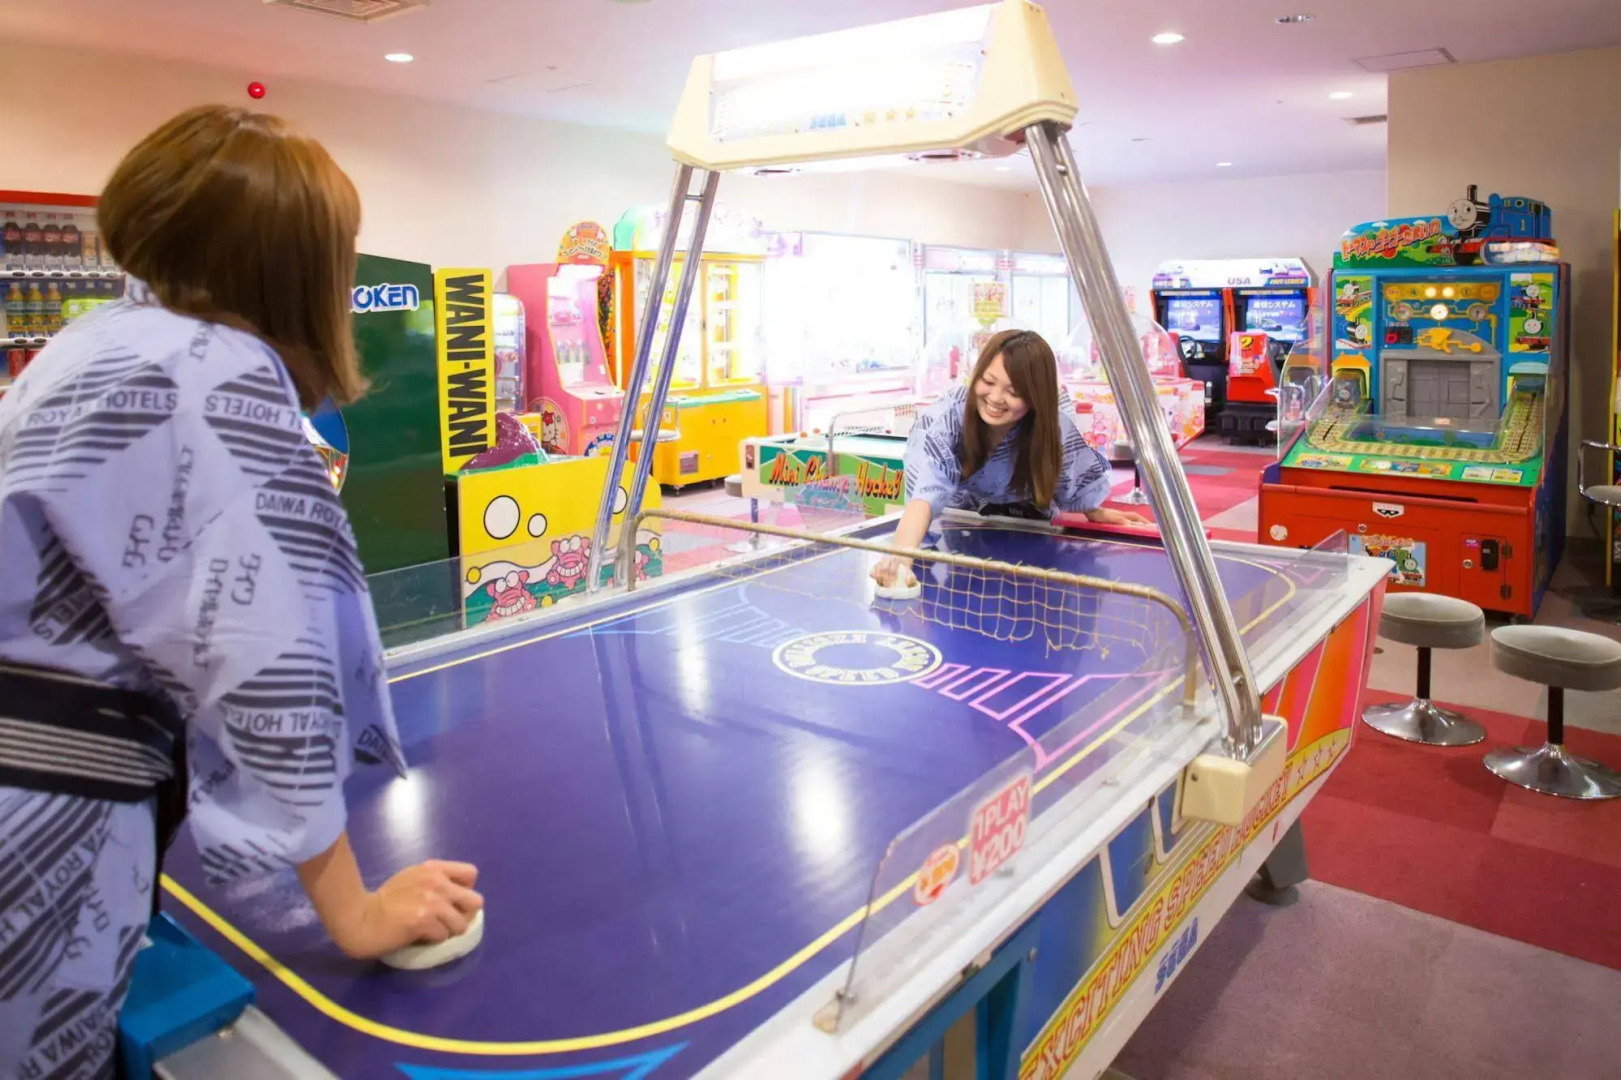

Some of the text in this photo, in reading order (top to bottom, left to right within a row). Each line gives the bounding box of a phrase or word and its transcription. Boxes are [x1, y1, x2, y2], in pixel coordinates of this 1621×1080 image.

[1227, 277, 1251, 285] USA
[352, 284, 418, 309] OKEN
[205, 394, 280, 424] HOTELS
[769, 451, 800, 486] Mini
[255, 492, 305, 515] DAIWA
